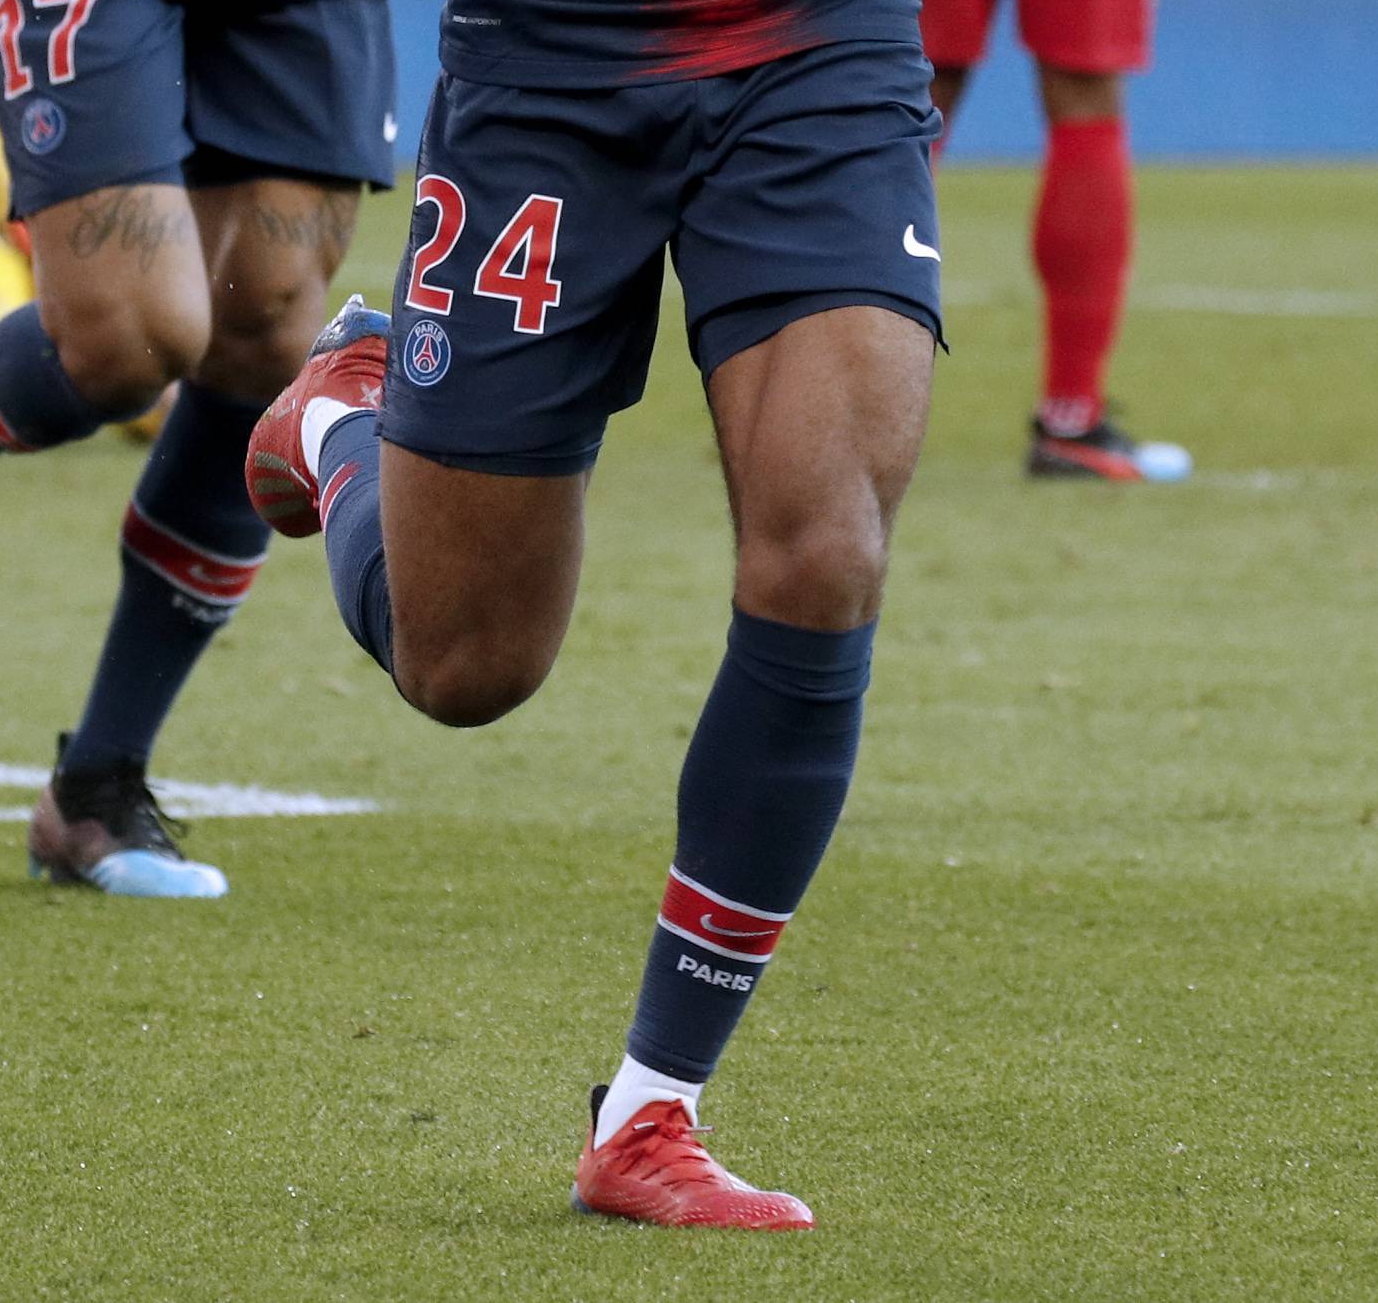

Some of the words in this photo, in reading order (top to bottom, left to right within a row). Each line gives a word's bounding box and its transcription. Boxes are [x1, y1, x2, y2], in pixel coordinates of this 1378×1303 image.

[406, 174, 563, 335] 24
[414, 323, 444, 343] PARIS
[676, 953, 755, 992] PARIS
